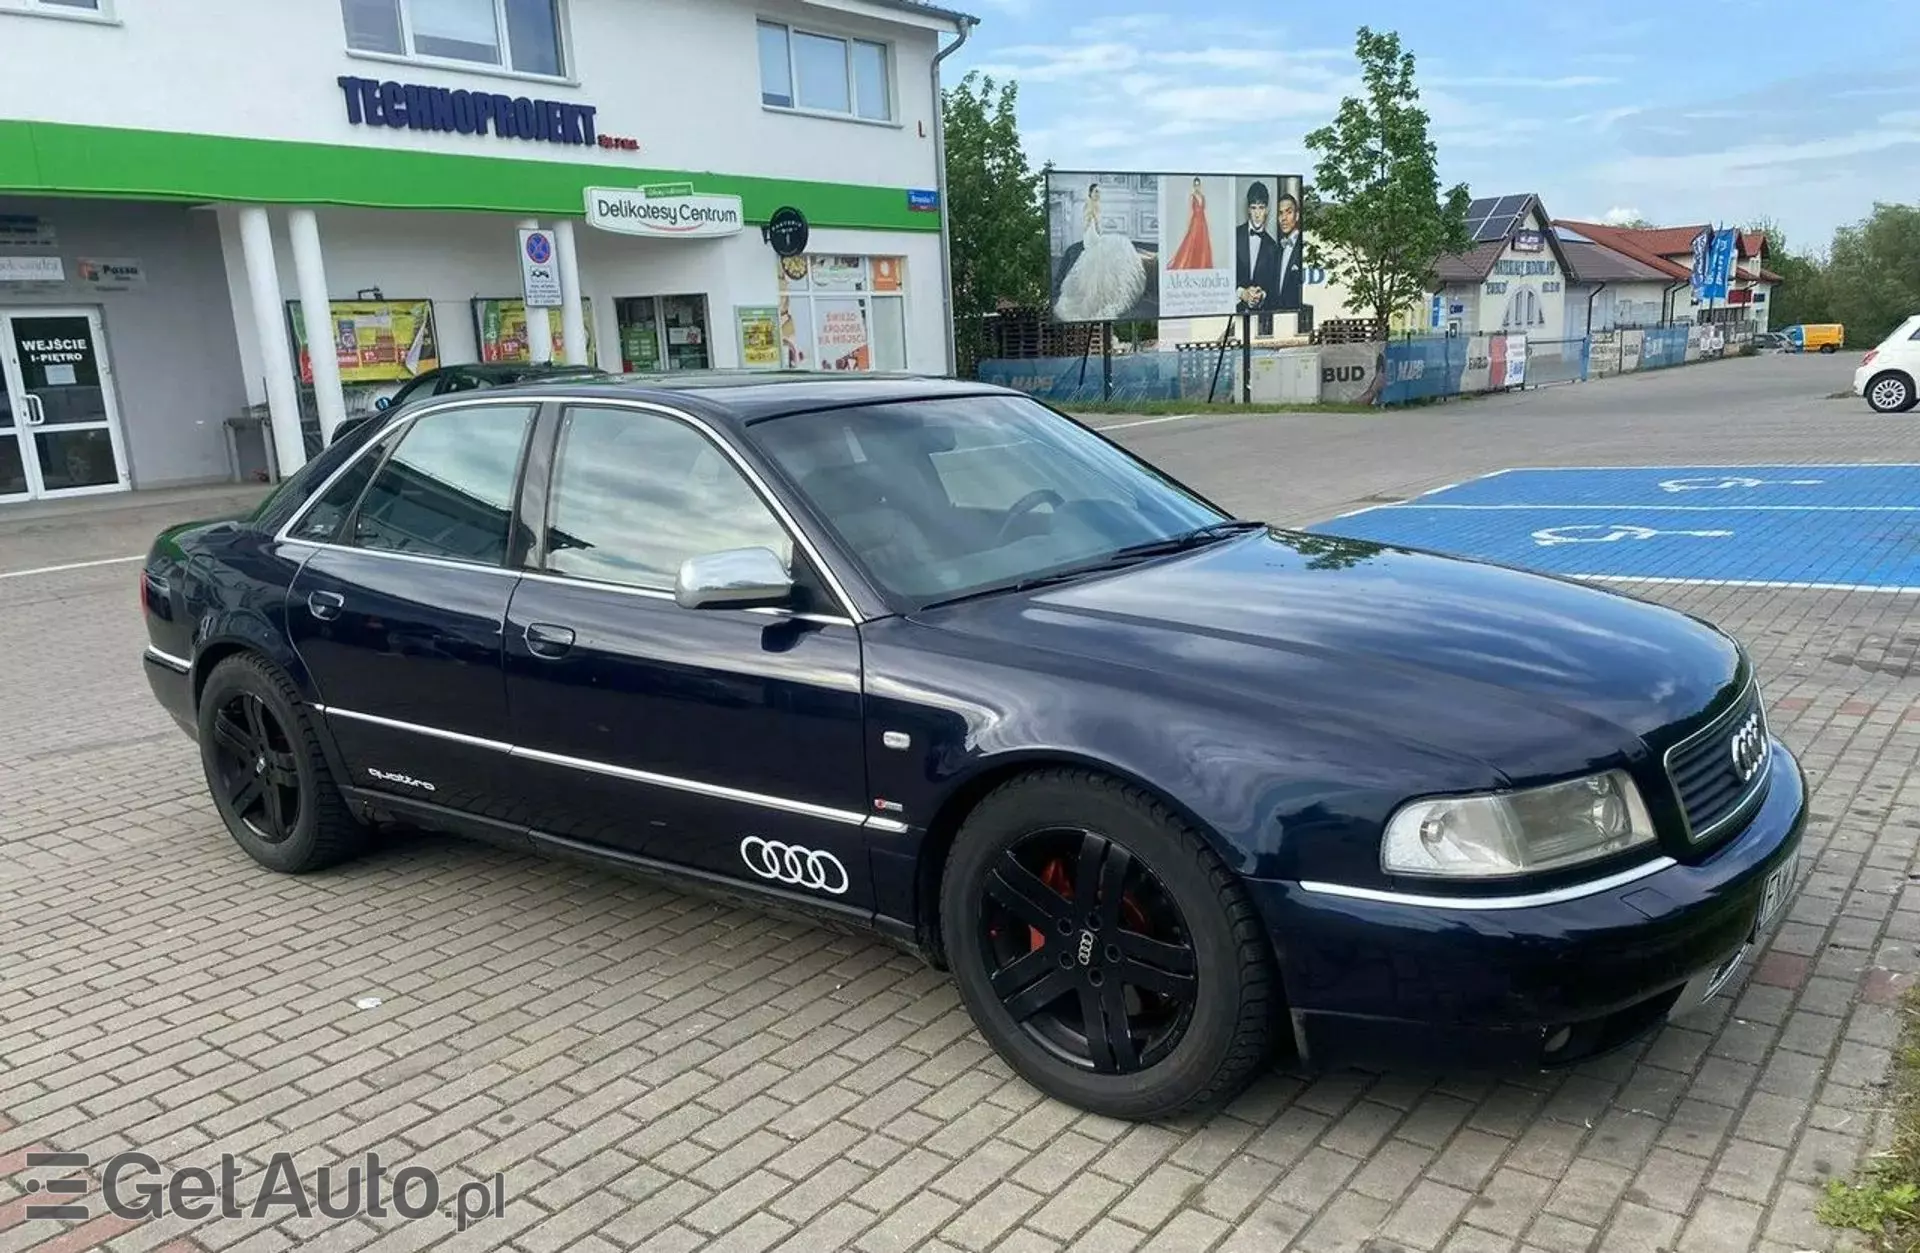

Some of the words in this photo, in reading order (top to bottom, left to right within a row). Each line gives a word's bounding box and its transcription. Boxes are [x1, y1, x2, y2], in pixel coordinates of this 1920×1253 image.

[338, 75, 597, 146] TECHNOPROJEKT
[598, 199, 678, 225] Delikatesy
[679, 203, 738, 222] Centrum
[22, 338, 87, 351] WEJŚCIE
[1322, 365, 1365, 382] BUD
